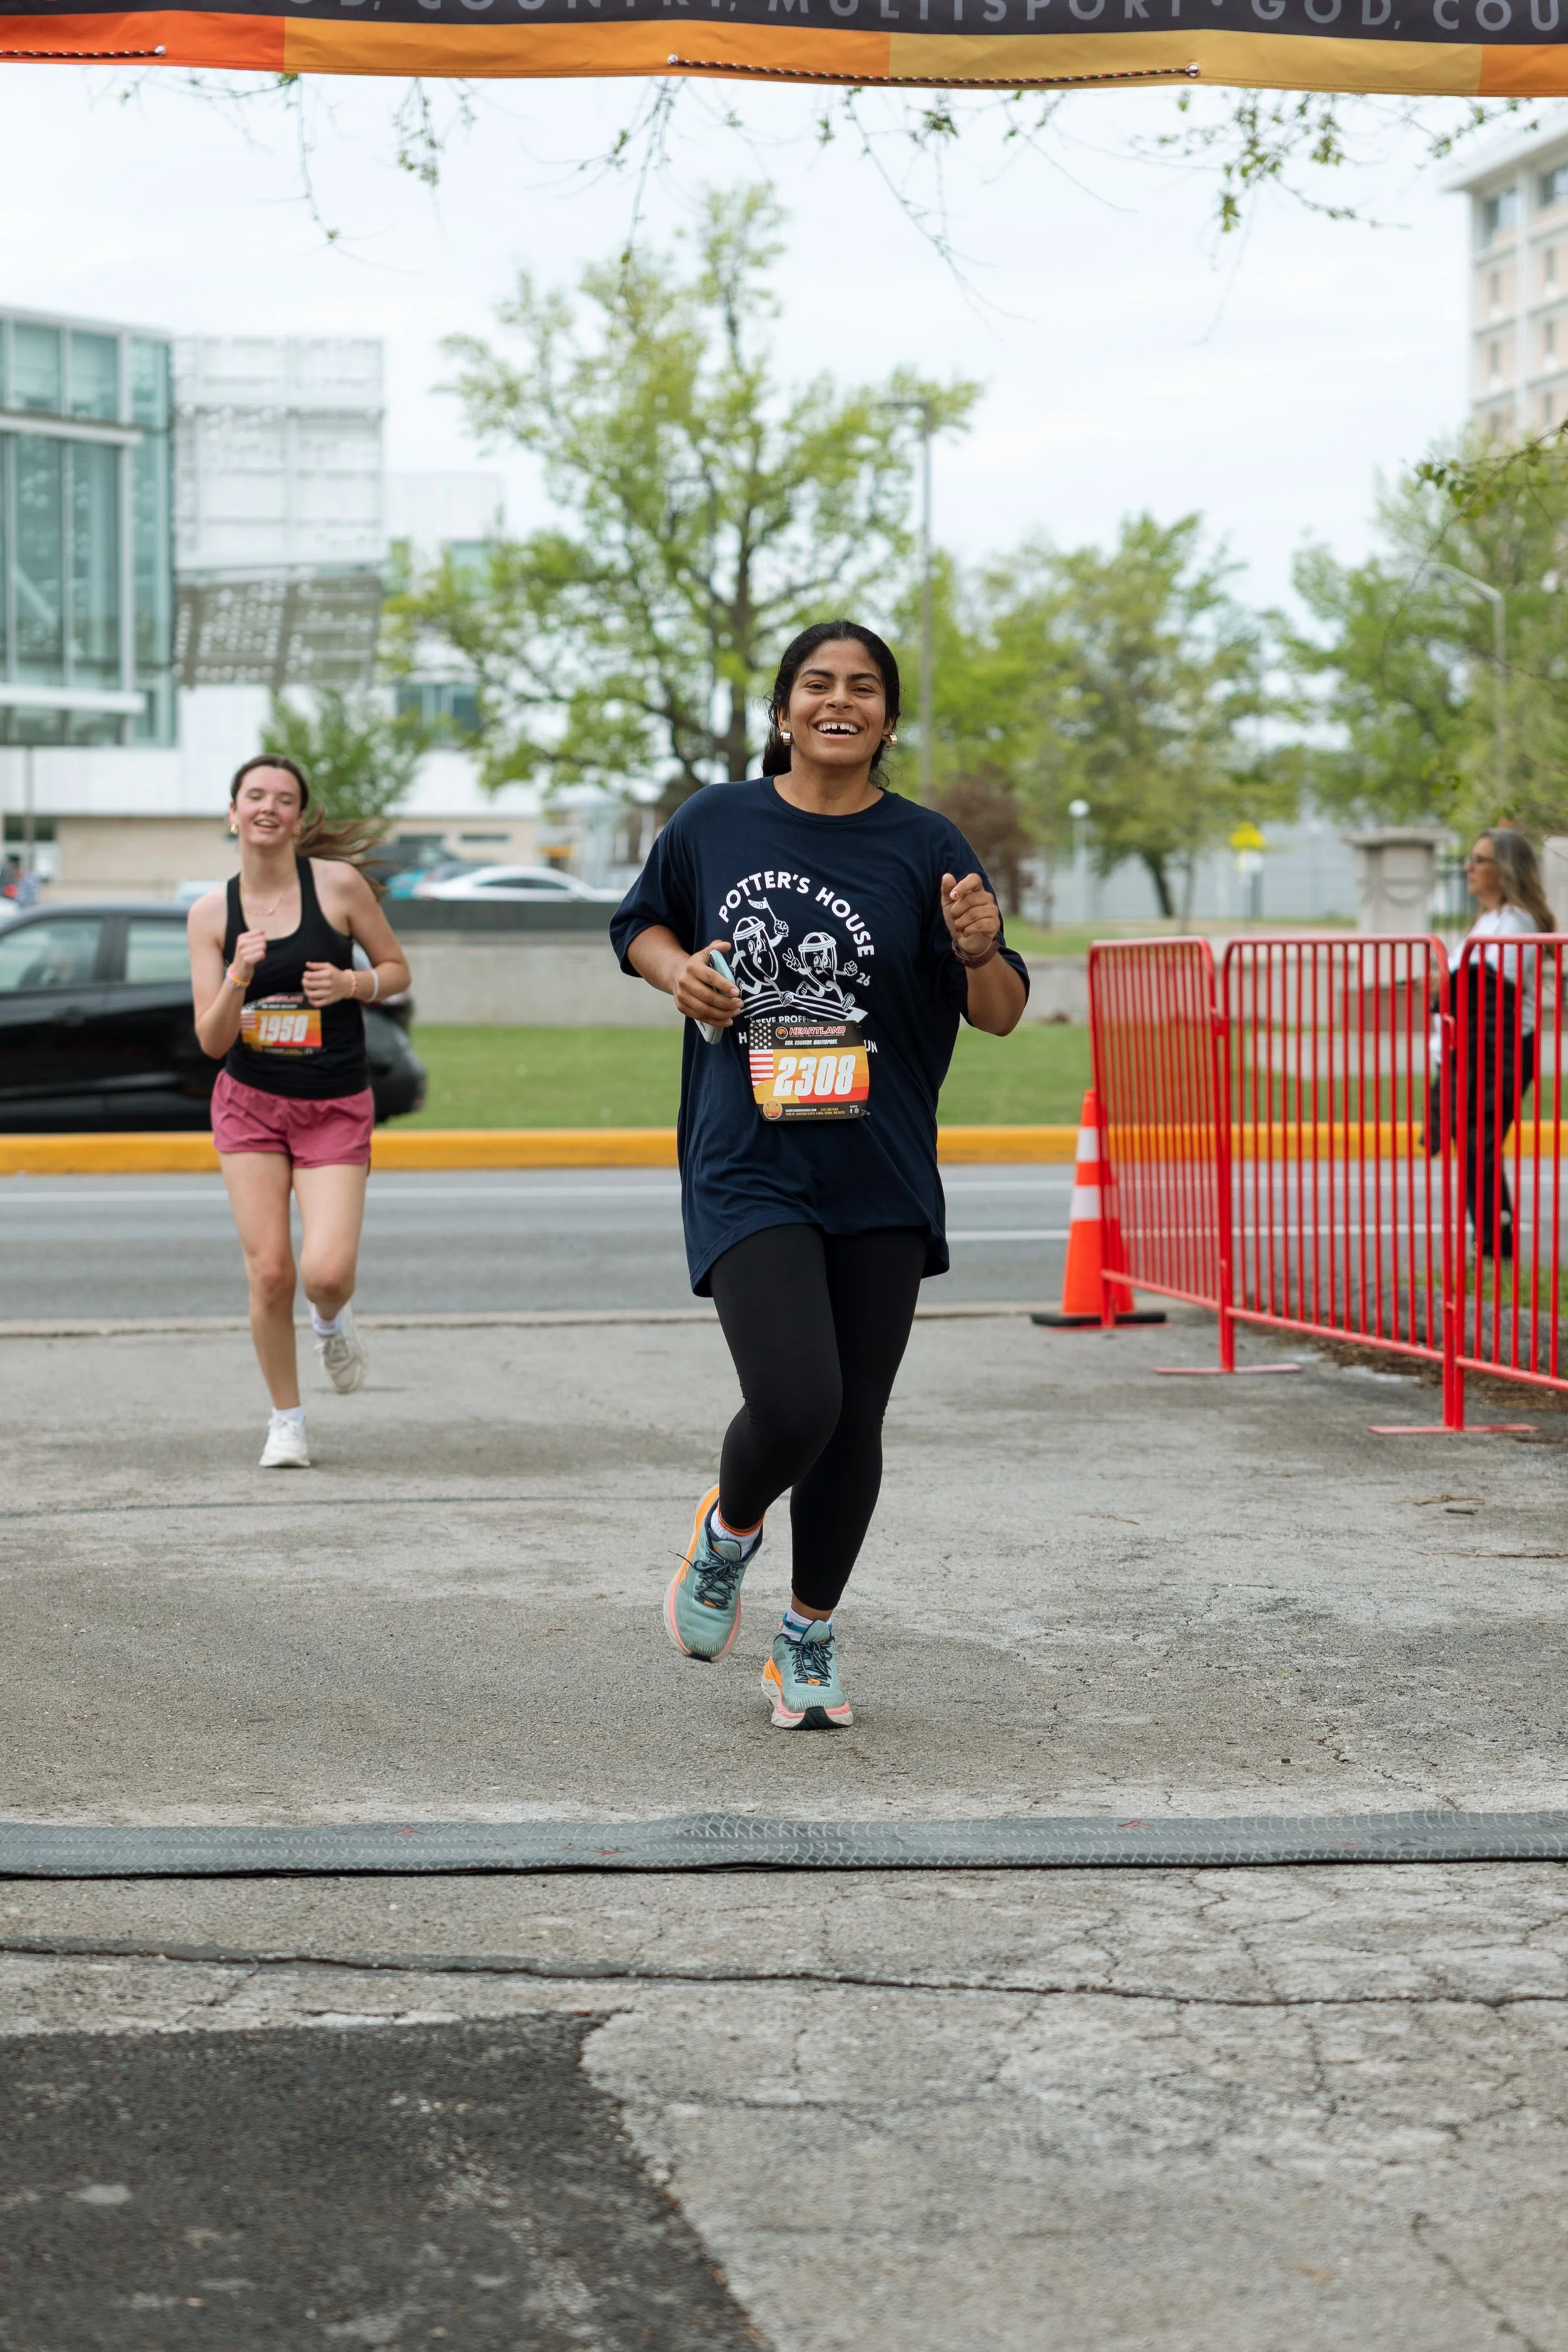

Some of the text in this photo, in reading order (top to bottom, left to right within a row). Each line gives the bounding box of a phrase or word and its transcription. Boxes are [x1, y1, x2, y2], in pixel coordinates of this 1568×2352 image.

[1251, 0, 1401, 29] GOD,
[718, 871, 875, 958] POTTER'S HOUSE
[856, 972, 871, 987] 26
[258, 1014, 309, 1042] 1950
[789, 1026, 846, 1035] HEARTLAND
[863, 1039, 878, 1053] UN
[773, 1055, 857, 1097] 2308
